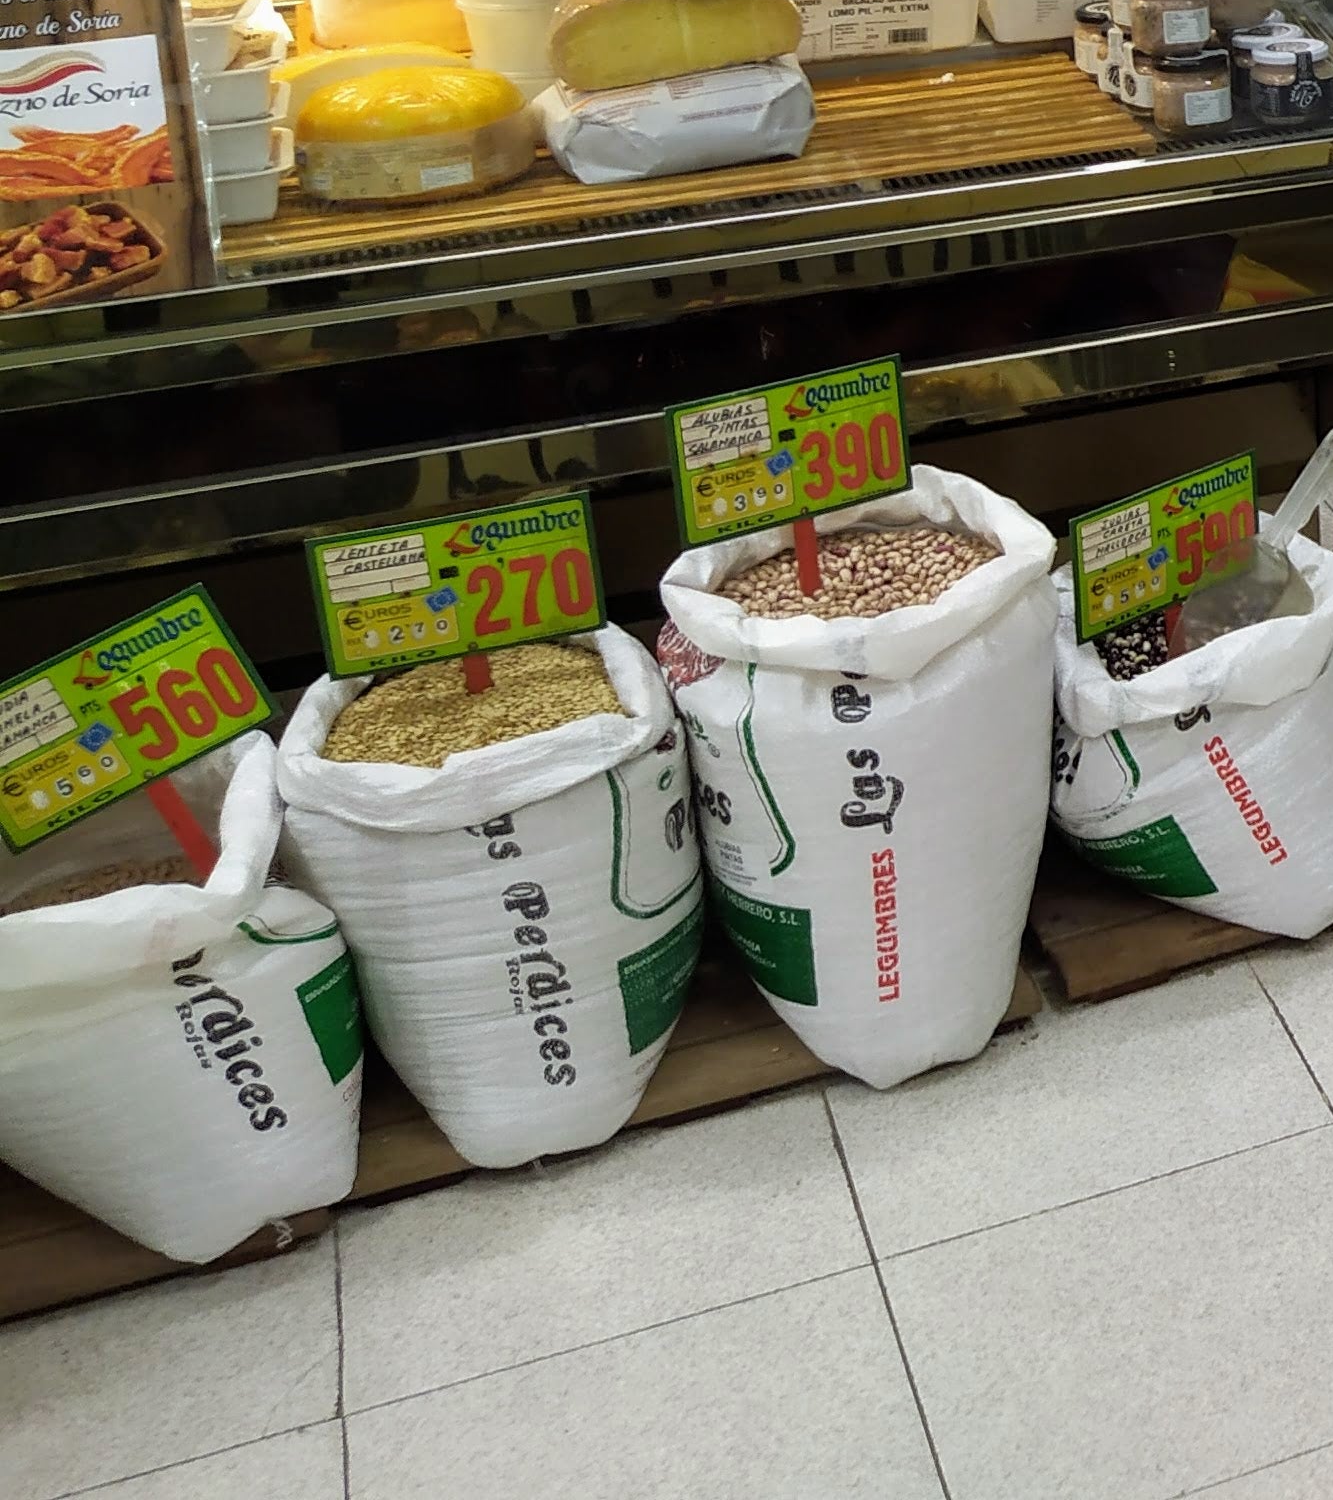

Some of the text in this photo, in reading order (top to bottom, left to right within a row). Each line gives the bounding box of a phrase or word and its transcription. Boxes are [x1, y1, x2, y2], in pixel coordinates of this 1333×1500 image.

[36, 17, 62, 37] de
[66, 10, 123, 34] Soria
[828, 2, 930, 19] LOMO PIL PIL EXTRA
[54, 85, 88, 108] de
[89, 79, 153, 105] Soria
[784, 371, 892, 418] Legumbre
[691, 404, 755, 429] ALUBIAS
[706, 416, 759, 439] PINTAS
[1162, 464, 1250, 515] Legumbre
[442, 507, 581, 556] Legumbre
[716, 512, 776, 536] KILO
[334, 538, 409, 562] LENTEJA
[343, 549, 426, 576] CASTELLANA
[1105, 603, 1151, 627] KILO
[72, 606, 205, 690] Legumbre
[369, 649, 437, 668] KILO
[47, 789, 115, 828] KILO
[1203, 735, 1289, 867] LEGUMBRES
[871, 847, 900, 1003] LEGUMBRES
